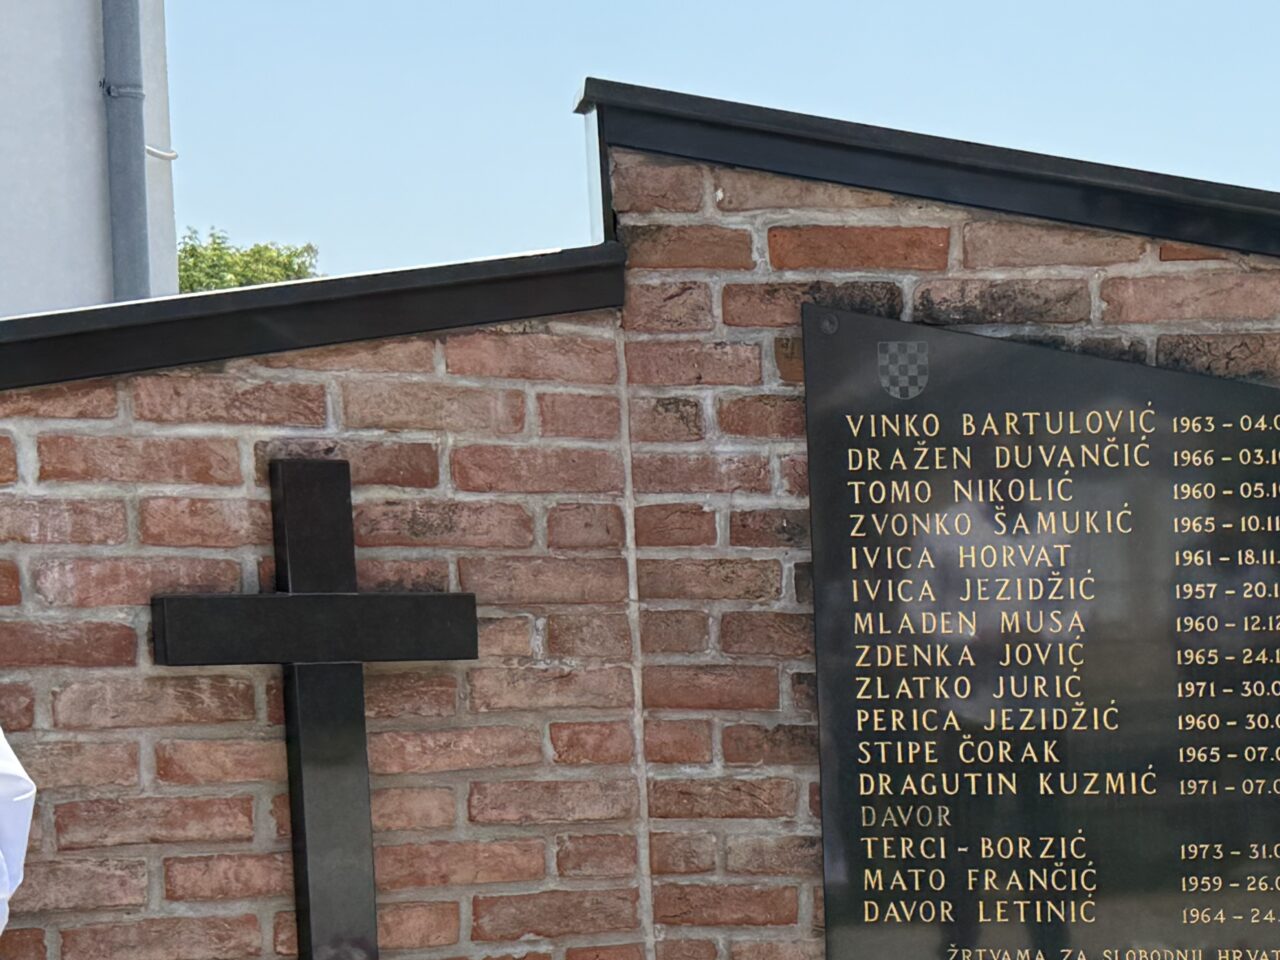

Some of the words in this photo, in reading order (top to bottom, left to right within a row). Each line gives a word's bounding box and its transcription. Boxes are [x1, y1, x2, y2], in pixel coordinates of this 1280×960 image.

[846, 413, 939, 437] VINKO
[963, 402, 1155, 436] BARTULOVIĆ
[1173, 416, 1215, 433] 1963
[848, 441, 971, 470] DRAŽEN
[996, 435, 1149, 468] DUVANČIĆ
[1174, 450, 1214, 466] 1966
[847, 480, 931, 504] TOMO
[953, 470, 1072, 502] NIKOLIĆ
[1174, 483, 1215, 499] 1960
[850, 513, 971, 536] ZVONKO
[994, 500, 1132, 535] ŠAMUKIĆ
[1174, 516, 1215, 533] 1965
[852, 547, 935, 569] IVICA
[960, 545, 1071, 568] HORVAT
[1176, 550, 1211, 566] 1961
[852, 579, 936, 602] IVICA
[960, 566, 1094, 601] JEZIDŽIĆ
[1176, 583, 1217, 599] 1957
[854, 611, 976, 637] MLADEN
[1001, 611, 1085, 633] MUSA
[1177, 616, 1218, 632] 1960
[856, 644, 976, 666] ZDENKA
[999, 635, 1084, 666] JOVIĆ
[1177, 649, 1218, 665] 1965
[856, 676, 971, 699] ZLATKO
[993, 664, 1081, 698] JURIĆ
[1178, 682, 1215, 697] 1971
[857, 709, 961, 731] PERICA
[984, 697, 1118, 730] JEZIDŽIĆ
[1178, 714, 1220, 730] 1960
[858, 741, 938, 763] STIPE
[959, 734, 1059, 763] ČORAK
[1179, 747, 1220, 762] 1965
[860, 773, 1016, 795] DRAGUTIN
[1040, 764, 1156, 795] KUZMIĆ
[1180, 780, 1216, 795] 1971
[861, 806, 951, 827] DAVOR
[860, 837, 945, 859] TERCI
[981, 829, 1086, 859] BORZIĆ
[1181, 844, 1223, 860] 1973
[865, 869, 945, 891] MATO
[968, 861, 1096, 891] FRANČIĆ
[1182, 876, 1222, 891] 1959
[864, 901, 954, 922] DAVOR
[979, 893, 1095, 923] LETINIĆ
[1183, 908, 1226, 923] 1964
